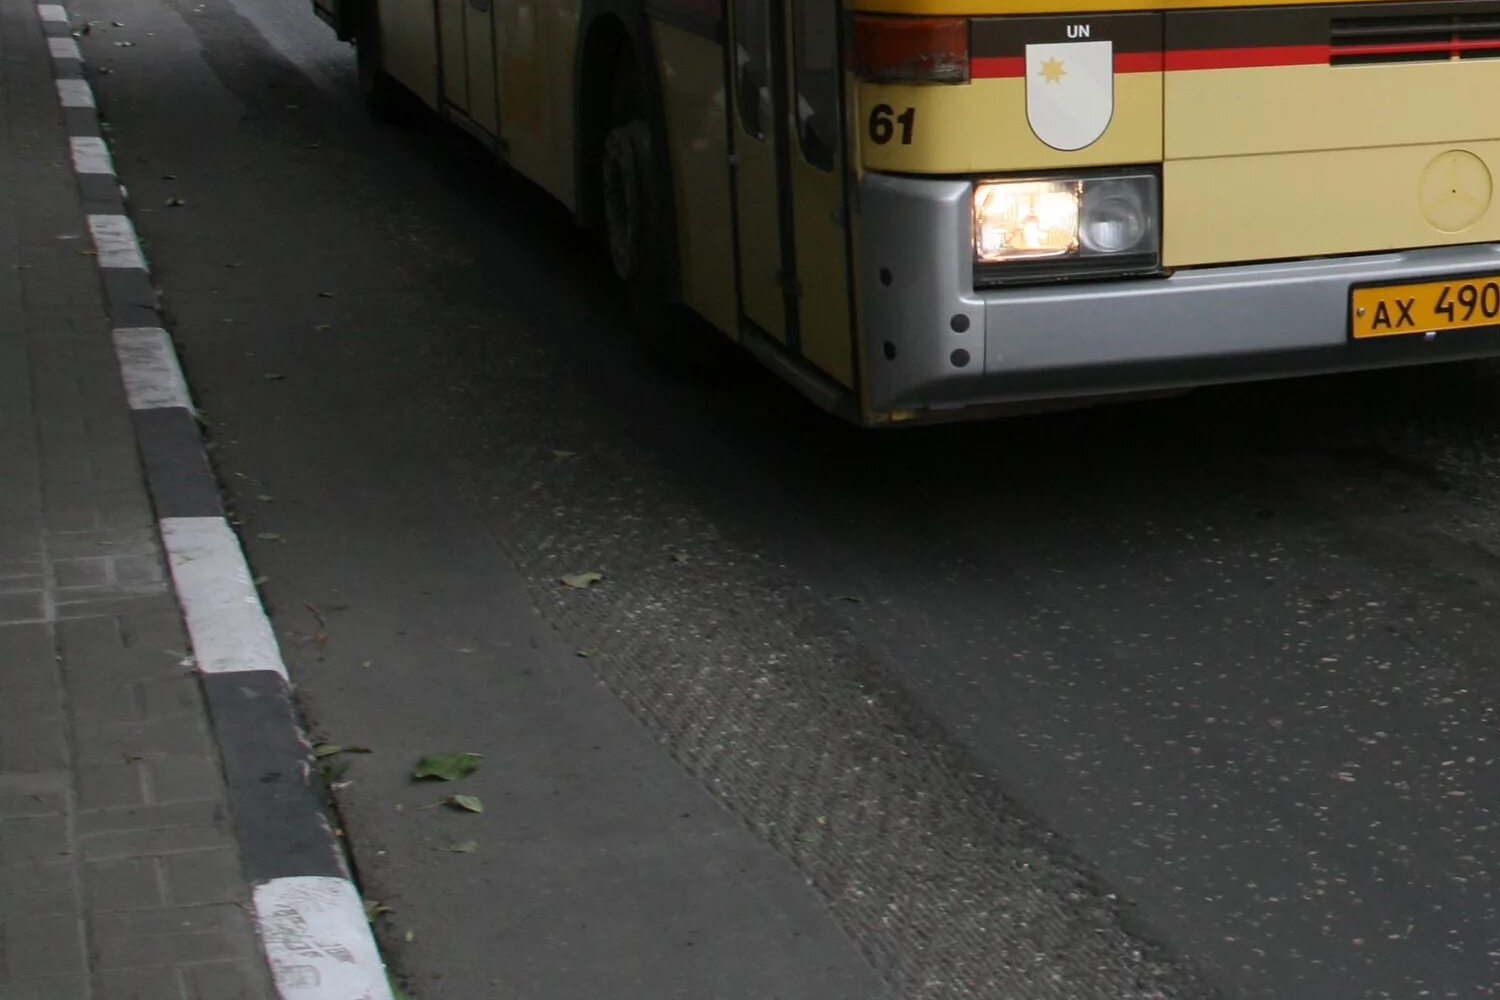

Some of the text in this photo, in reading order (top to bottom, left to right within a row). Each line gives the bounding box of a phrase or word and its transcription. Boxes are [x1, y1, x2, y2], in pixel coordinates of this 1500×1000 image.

[1066, 24, 1091, 39] UN
[868, 103, 916, 146] 61
[1433, 281, 1500, 322] 490
